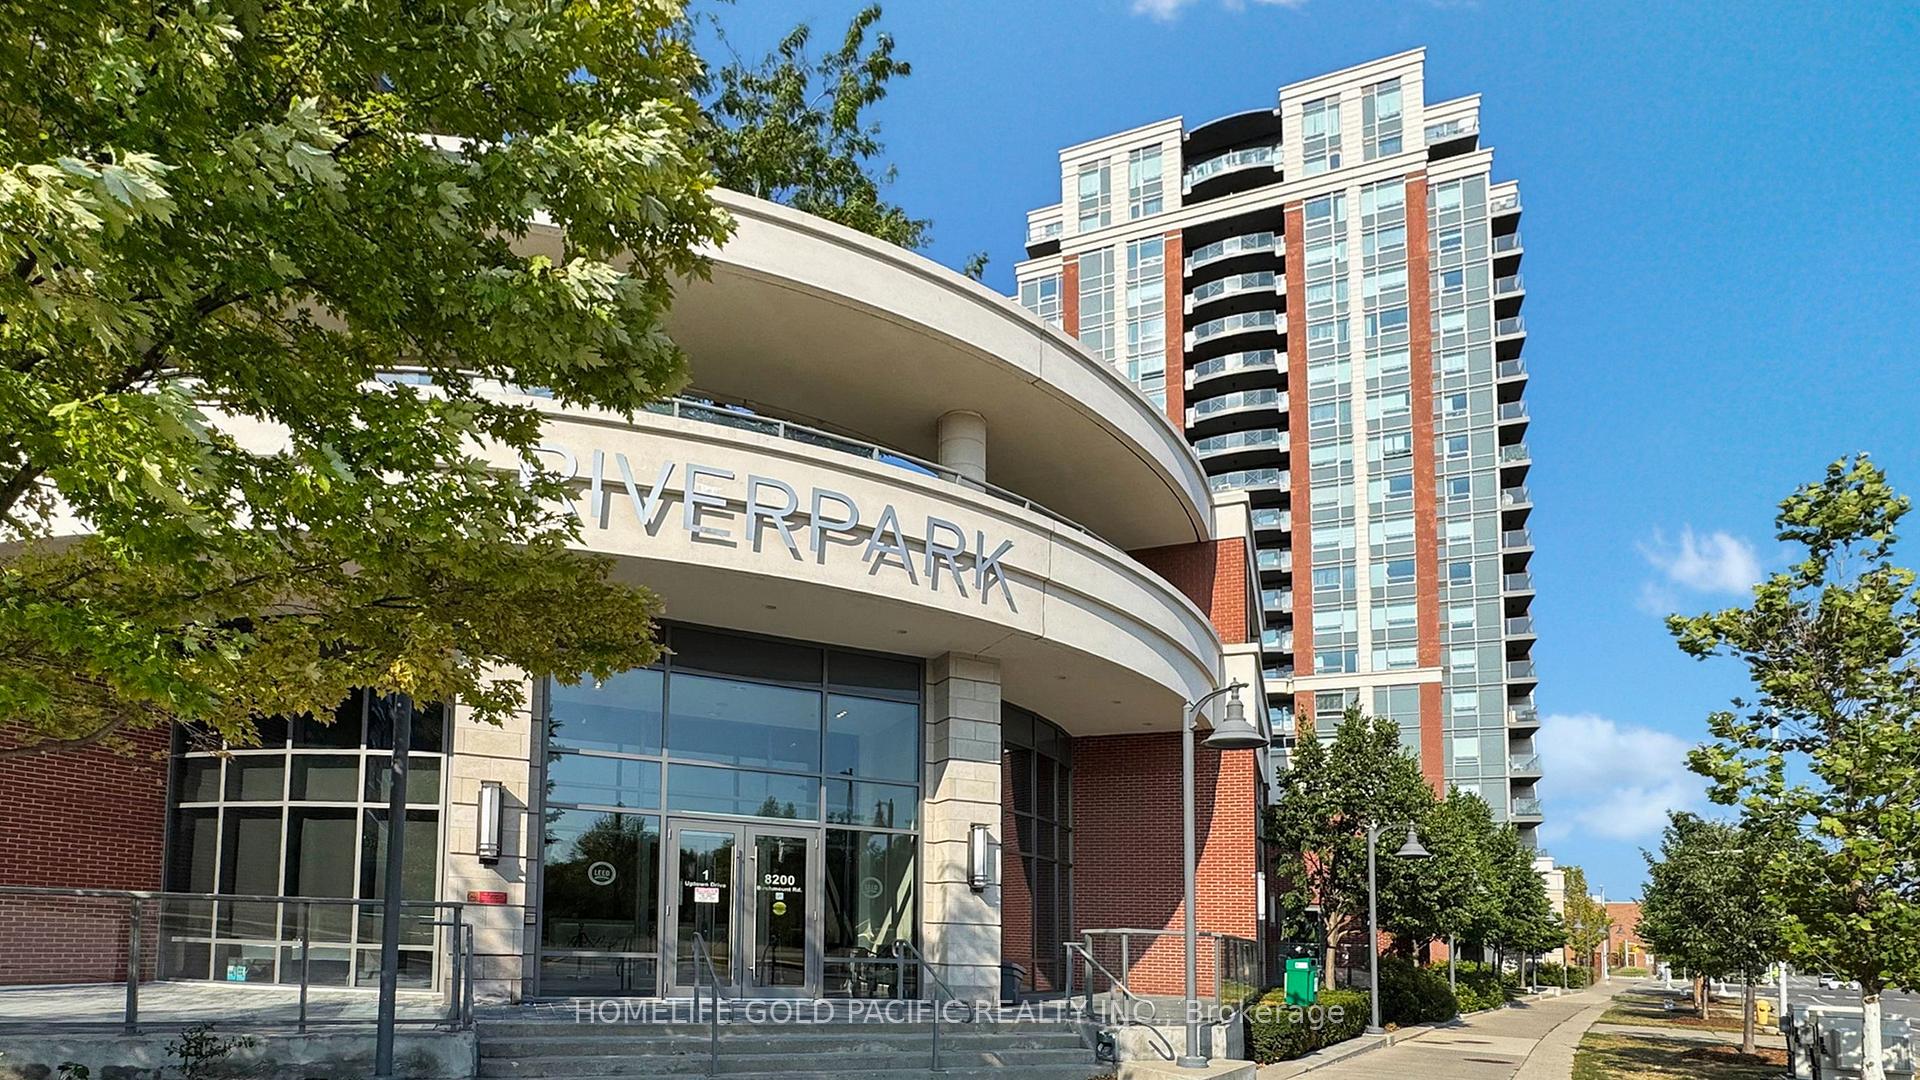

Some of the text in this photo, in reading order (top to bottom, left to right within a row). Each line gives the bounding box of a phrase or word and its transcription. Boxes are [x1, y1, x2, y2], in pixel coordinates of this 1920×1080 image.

[519, 443, 1018, 614] RIVERPARK
[702, 869, 709, 880] 1
[764, 874, 796, 886] 8200
